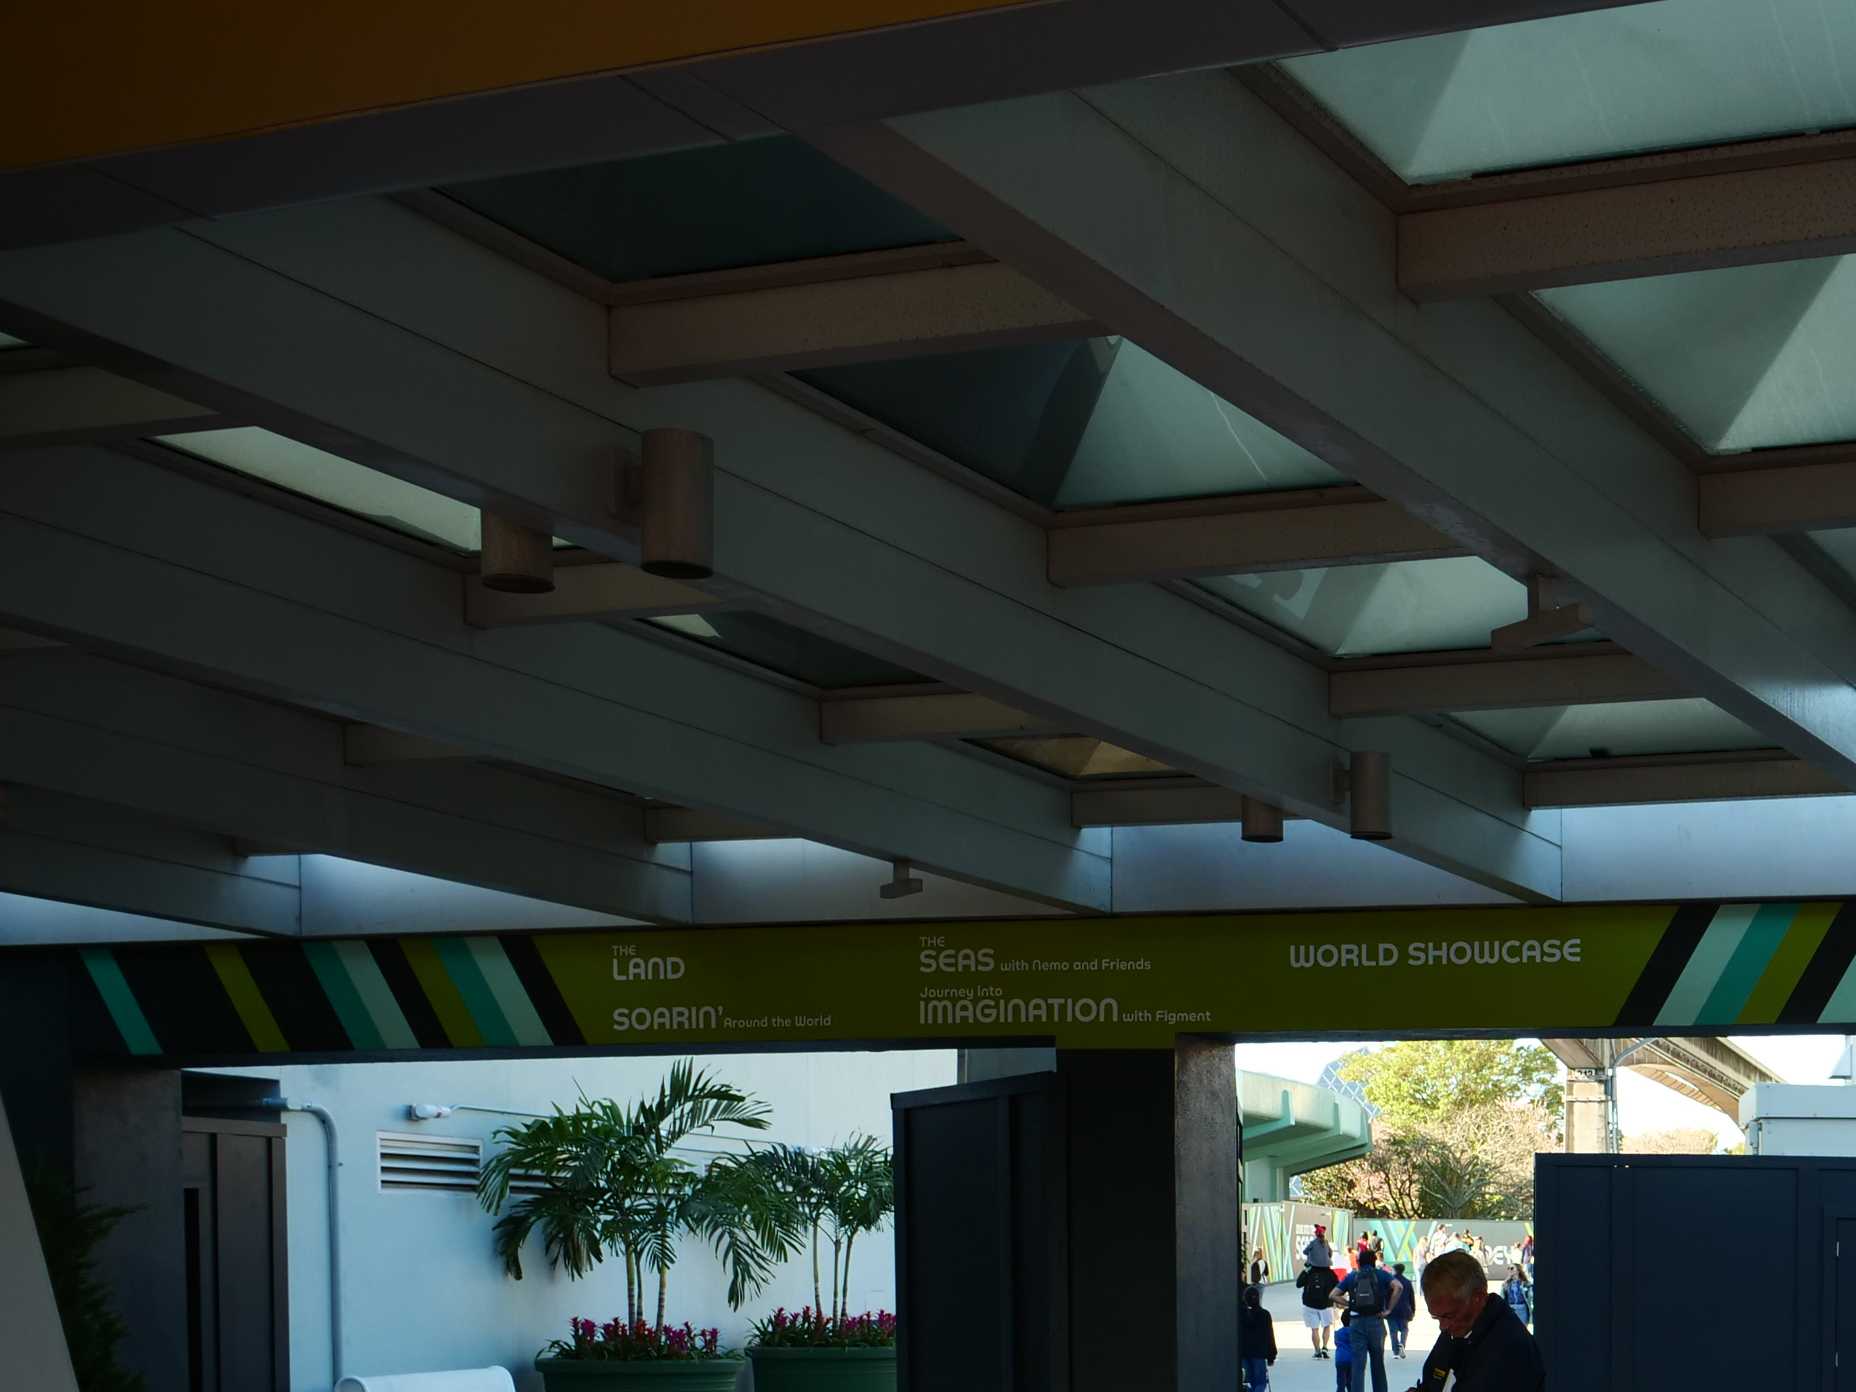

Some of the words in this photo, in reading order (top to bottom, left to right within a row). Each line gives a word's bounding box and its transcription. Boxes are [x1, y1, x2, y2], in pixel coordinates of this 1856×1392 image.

[612, 945, 638, 957] THE
[920, 936, 945, 948] THE
[1289, 942, 1400, 968] WORLD
[1407, 937, 1582, 966] SHOWCASE
[612, 957, 686, 981] LAND
[919, 948, 995, 973] SEAS
[1000, 960, 1029, 972] with
[1032, 960, 1070, 971] Nemo
[1072, 958, 1098, 971] and
[1102, 957, 1152, 970] Friends
[920, 986, 974, 1000] Journey
[612, 1006, 724, 1031] SOARIN'
[723, 1016, 768, 1029] Around
[771, 1015, 792, 1028] the
[795, 1014, 832, 1027] World
[919, 998, 1118, 1024] IMAGINATION
[1122, 1009, 1152, 1022] with
[1155, 1009, 1212, 1025] Figment
